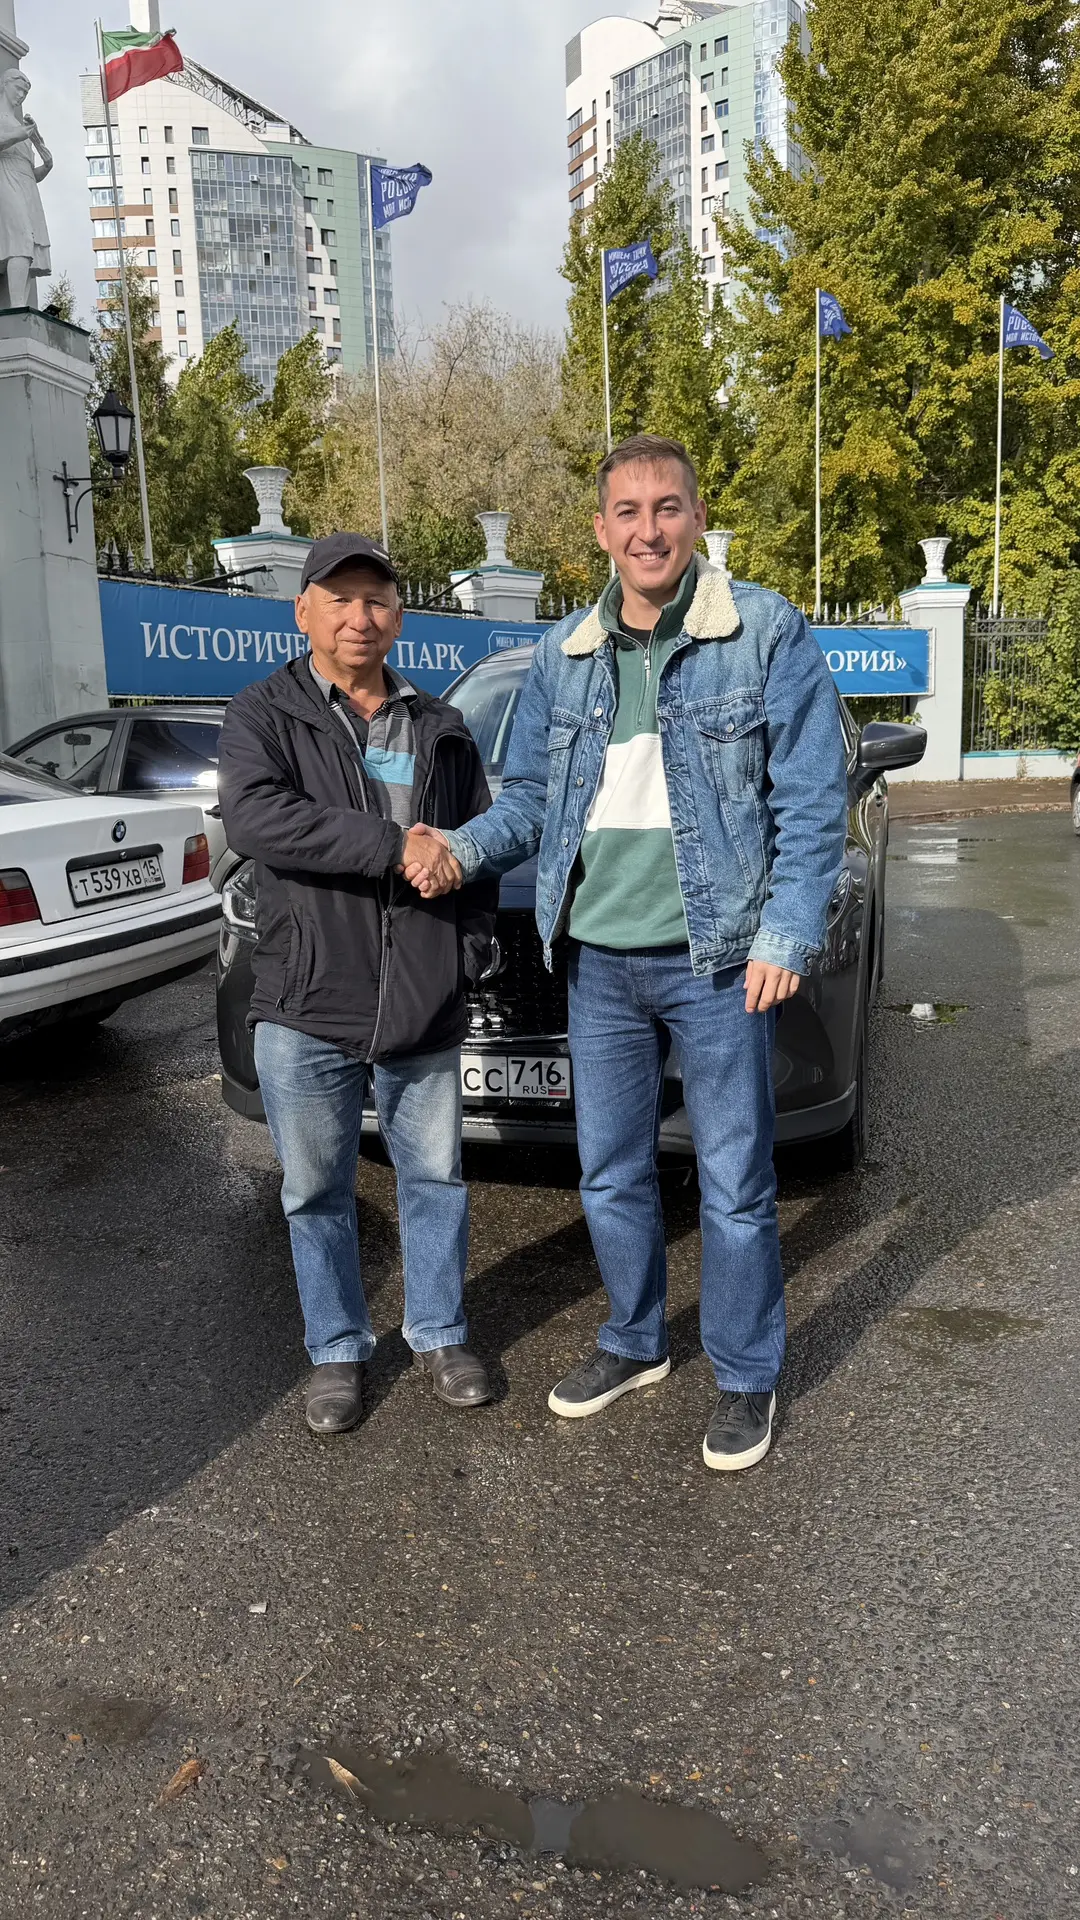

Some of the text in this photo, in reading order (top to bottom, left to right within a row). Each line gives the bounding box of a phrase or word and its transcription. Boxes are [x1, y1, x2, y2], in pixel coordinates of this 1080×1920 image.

[140, 621, 467, 672] ИСТОРИЧЕ ПАРК
[822, 650, 907, 672] ОРИЯ»
[511, 1060, 562, 1086] 716
[523, 1085, 547, 1095] RUS
